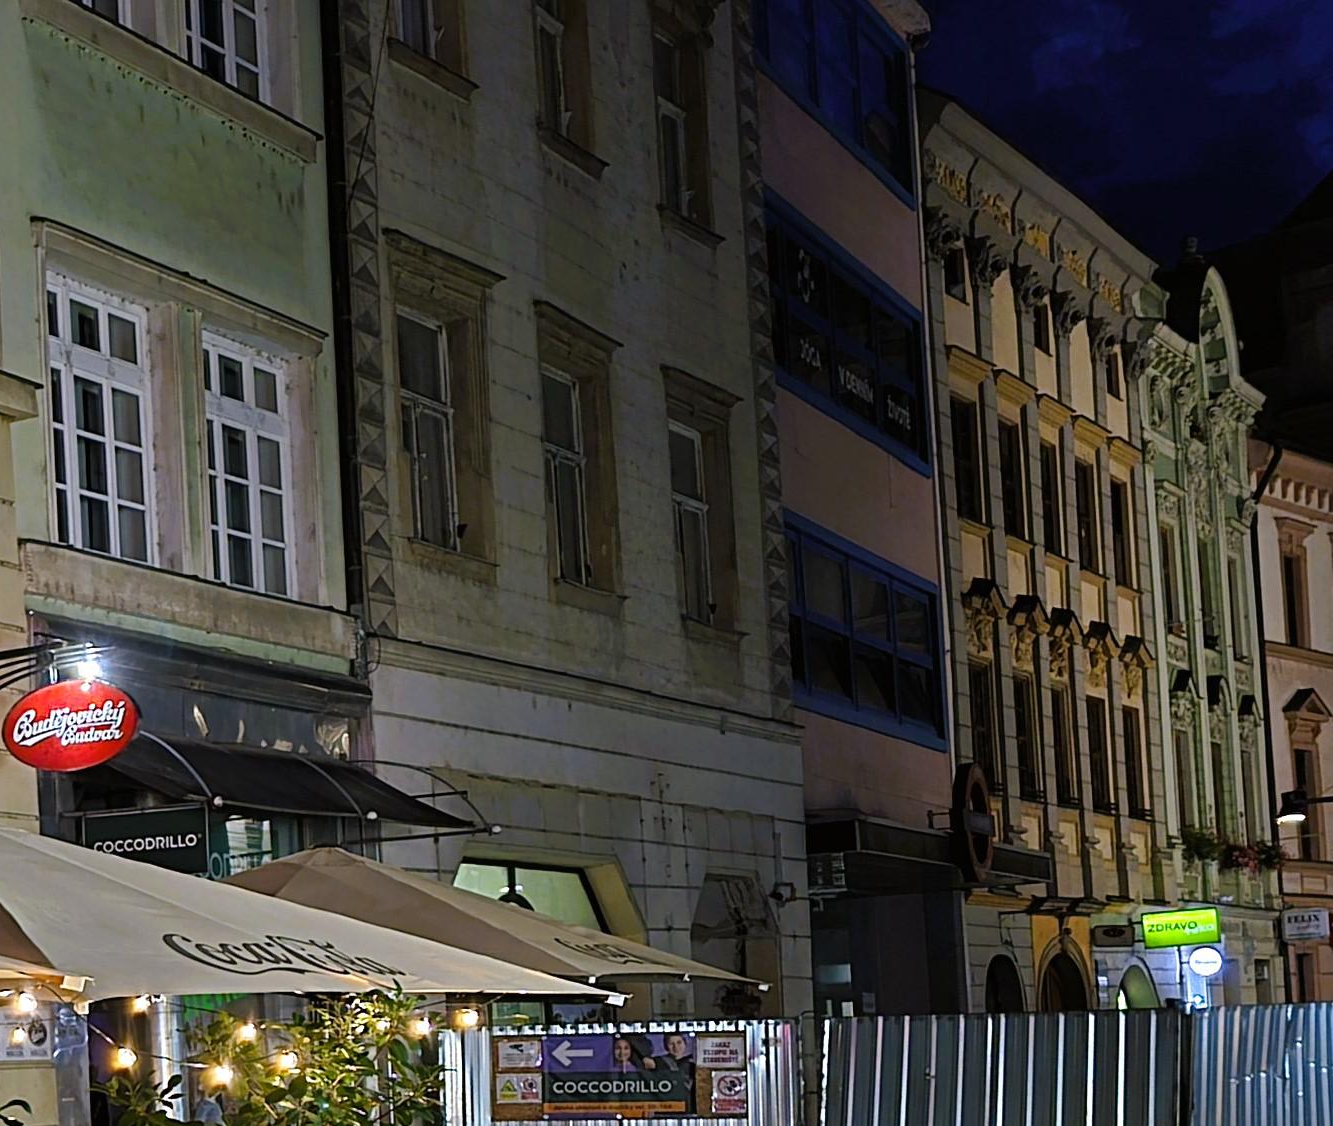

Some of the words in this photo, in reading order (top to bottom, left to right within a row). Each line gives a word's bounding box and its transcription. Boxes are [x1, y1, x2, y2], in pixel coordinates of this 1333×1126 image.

[13, 700, 126, 743] Budějovický
[61, 727, 123, 746] Budvar
[94, 833, 197, 854] COCCODRILLO
[1148, 921, 1198, 933] ZDRAVO
[552, 1079, 672, 1094] COCCODRILLO
